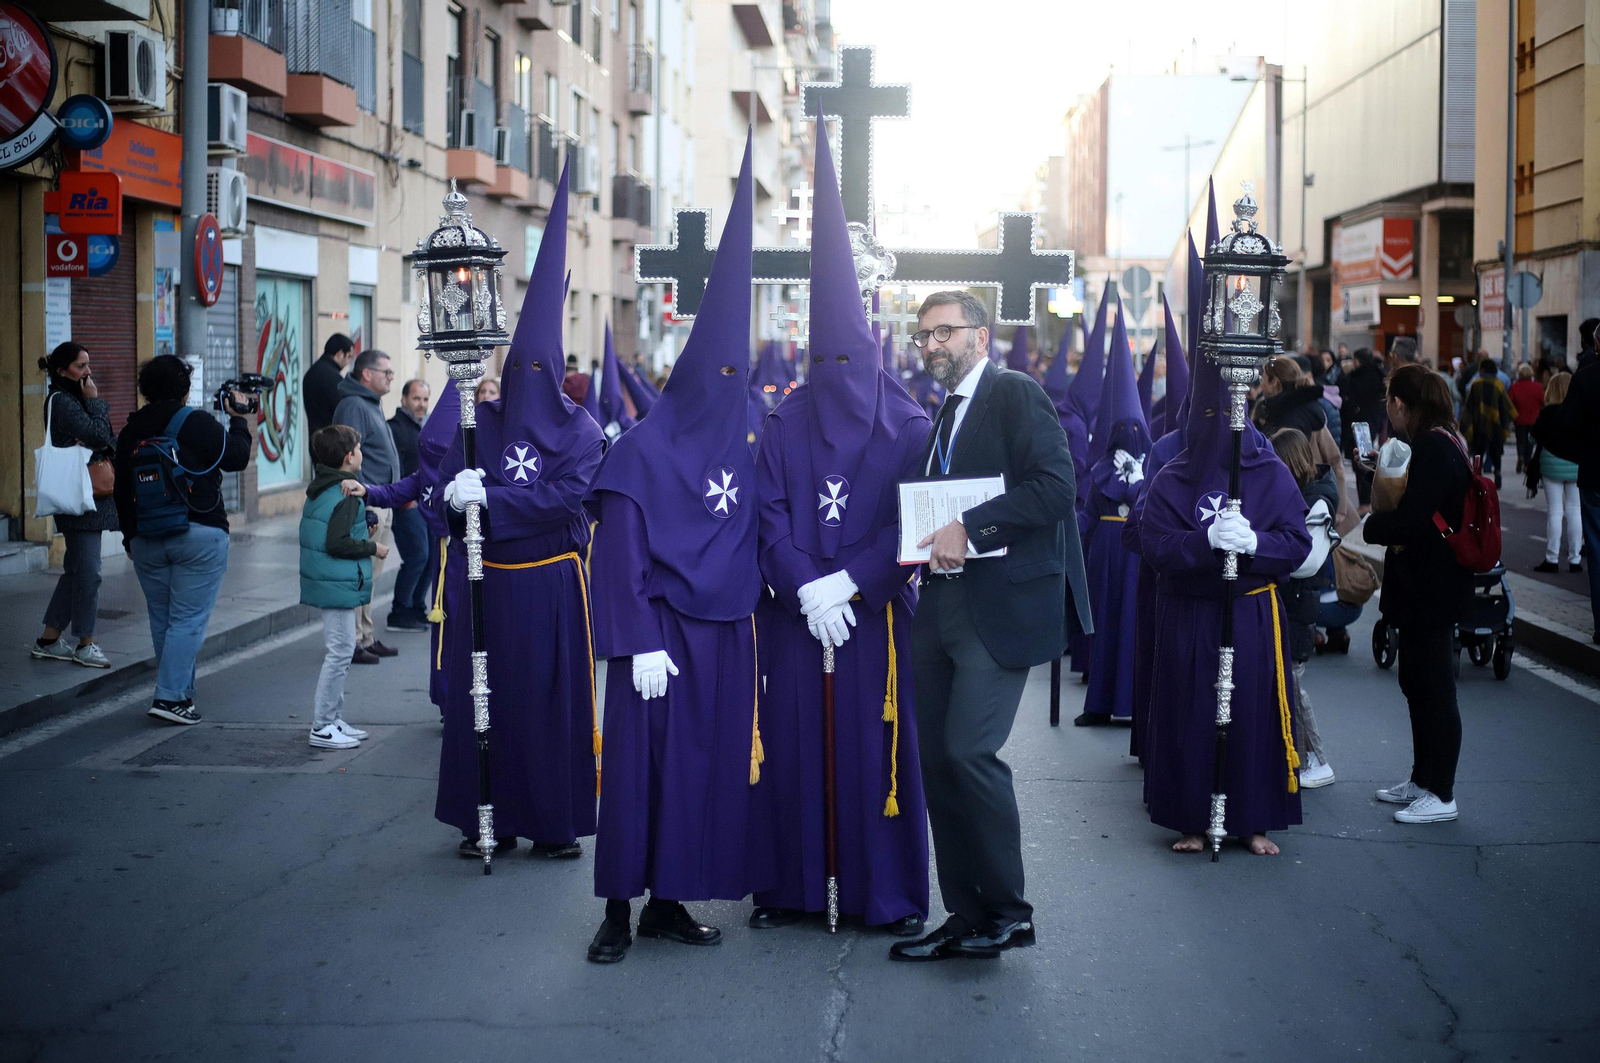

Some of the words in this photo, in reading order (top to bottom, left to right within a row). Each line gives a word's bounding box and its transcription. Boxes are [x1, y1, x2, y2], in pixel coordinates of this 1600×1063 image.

[61, 118, 104, 128] DIGI
[14, 131, 36, 153] SOL
[69, 187, 108, 210] Ria
[89, 244, 115, 255] IGI
[51, 263, 84, 271] vodafone
[138, 473, 158, 482] LiveU
